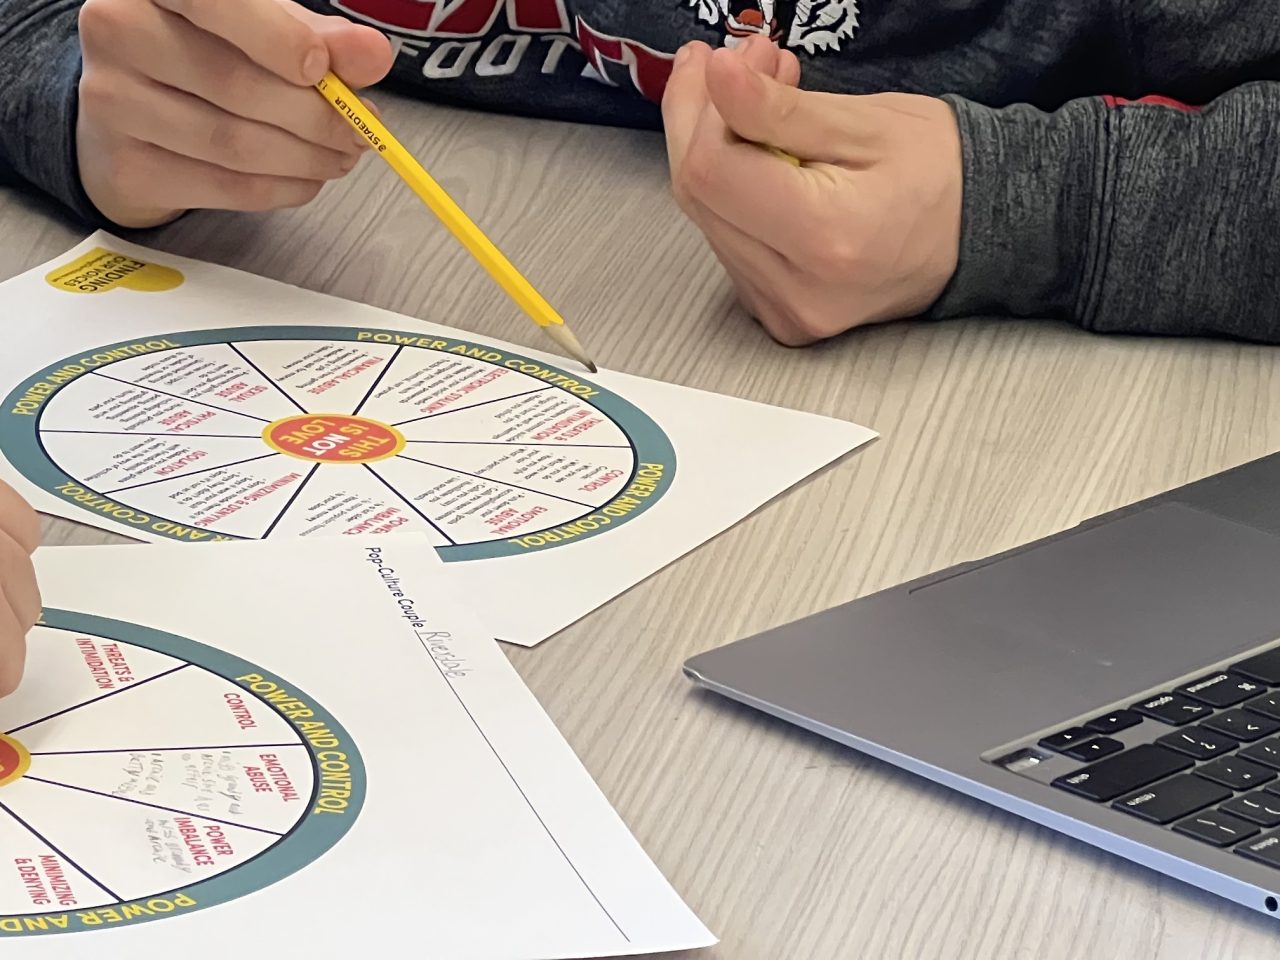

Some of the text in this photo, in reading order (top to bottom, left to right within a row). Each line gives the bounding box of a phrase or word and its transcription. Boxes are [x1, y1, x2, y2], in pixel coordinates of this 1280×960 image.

[335, 96, 380, 147] STAEDTLER
[79, 260, 146, 293] FINDING
[13, 384, 51, 415] POWER
[46, 361, 78, 387] AND
[83, 338, 180, 375] CONTROL
[357, 331, 447, 351] POWER
[448, 341, 502, 364] AND
[504, 357, 599, 399] CONTROL
[279, 419, 335, 445] LOVE
[302, 423, 369, 456] IS NOT
[338, 436, 390, 458] THIS
[154, 450, 208, 476] ISOLATION
[578, 469, 624, 492] CONTROL
[54, 481, 208, 541] AND CONTROL
[194, 504, 242, 527] DENYING
[484, 508, 519, 526] ABUSE
[490, 506, 548, 535] EMOTIONAL
[507, 463, 663, 548] POWER AND CONTROL
[365, 547, 426, 628] Pop-Culture Couple
[76, 638, 114, 689] INTIMIDATION
[102, 643, 132, 675] THREATS
[224, 693, 257, 730] CONTROL
[236, 673, 352, 814] POWER AND CONTROL
[243, 766, 273, 792] ABUSE
[259, 754, 299, 802] EMOTIONAL
[174, 817, 214, 866] IMBALANCE
[203, 825, 234, 855] POWER
[18, 866, 50, 905] DENYING
[39, 855, 77, 906] MINIMIZING
[3, 912, 72, 933] AND
[77, 893, 196, 926] POWER
